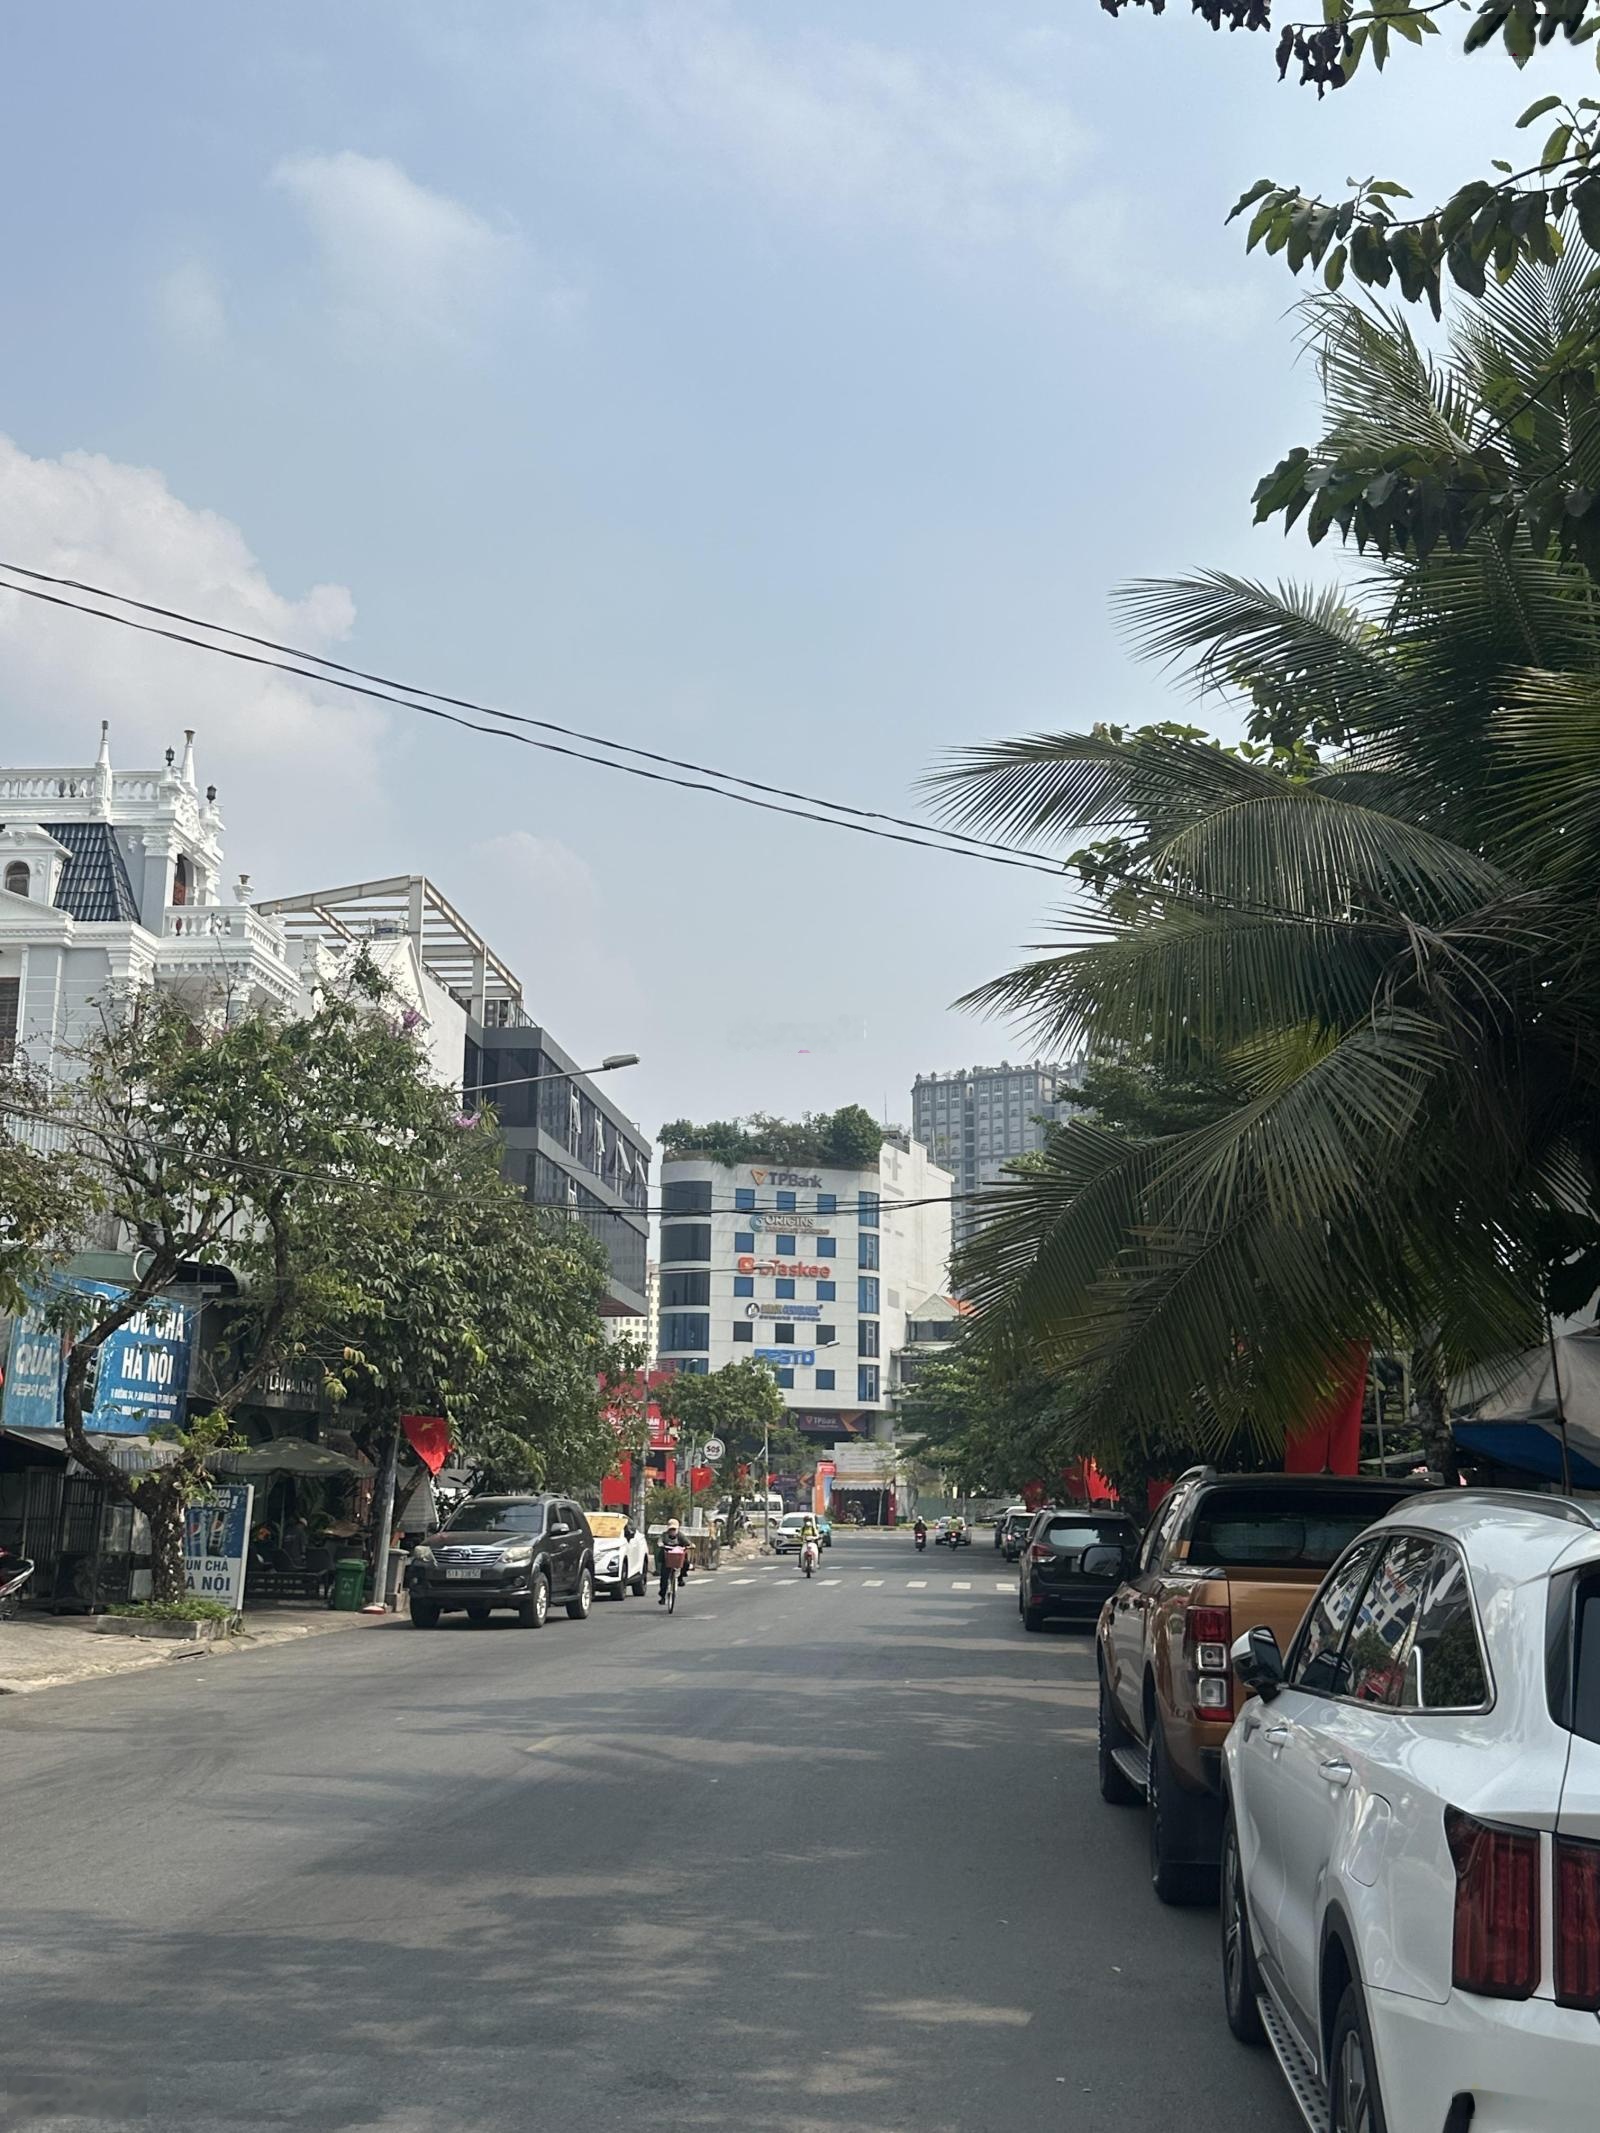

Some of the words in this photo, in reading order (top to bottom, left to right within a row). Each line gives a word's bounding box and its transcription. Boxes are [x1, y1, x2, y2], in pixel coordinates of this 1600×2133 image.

[769, 1171, 823, 1188] TPBank
[121, 1341, 143, 1381] HÀ
[146, 1346, 174, 1391] NỘI
[201, 1573, 231, 1595] NỘI
